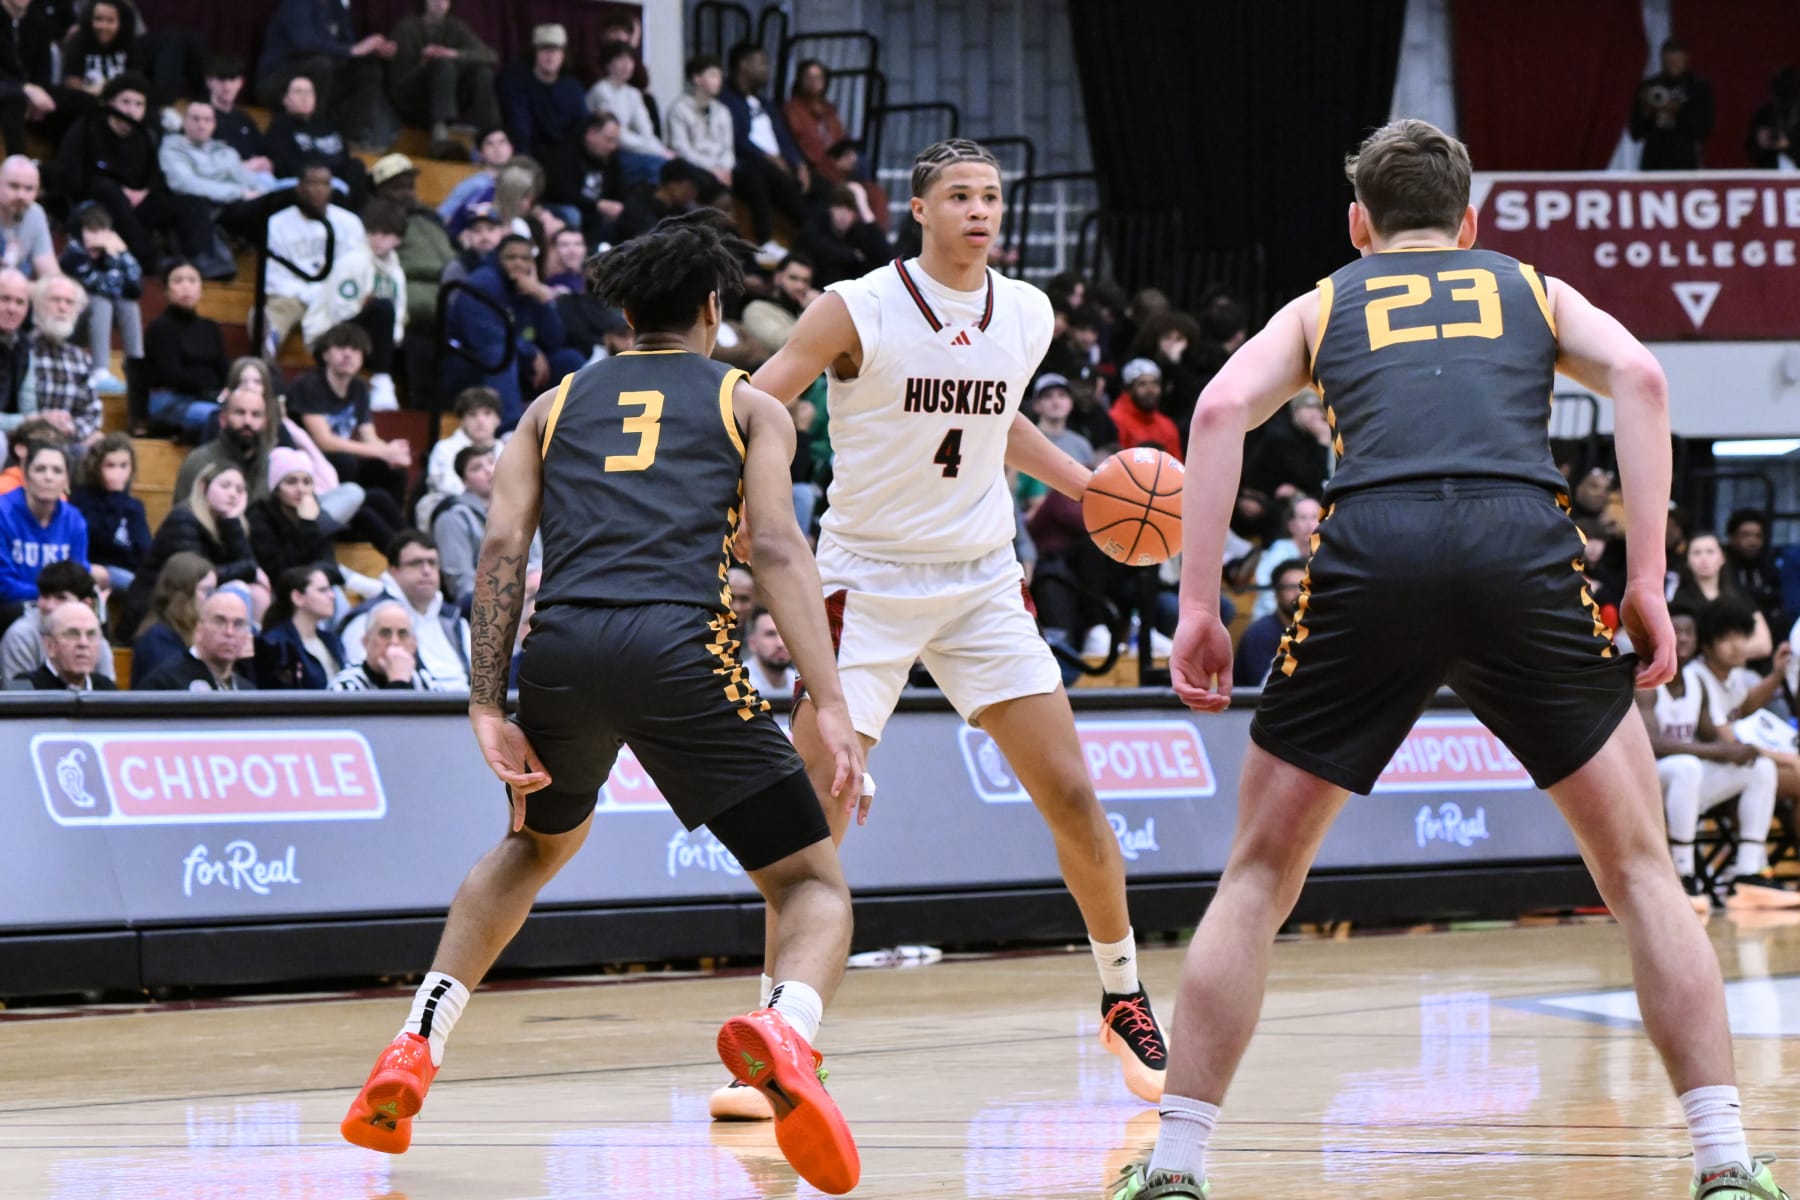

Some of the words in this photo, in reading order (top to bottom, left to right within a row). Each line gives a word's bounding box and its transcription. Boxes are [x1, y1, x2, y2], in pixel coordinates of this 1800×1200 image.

[1594, 240, 1796, 268] COLLEGE
[1364, 268, 1504, 351] 23
[903, 377, 1007, 415] HUSKIES
[604, 390, 665, 472] 3
[933, 428, 964, 478] 4
[118, 753, 366, 799] CHIPOTLE
[1084, 740, 1200, 780] POTLE
[1382, 735, 1521, 775] HIPOTLE
